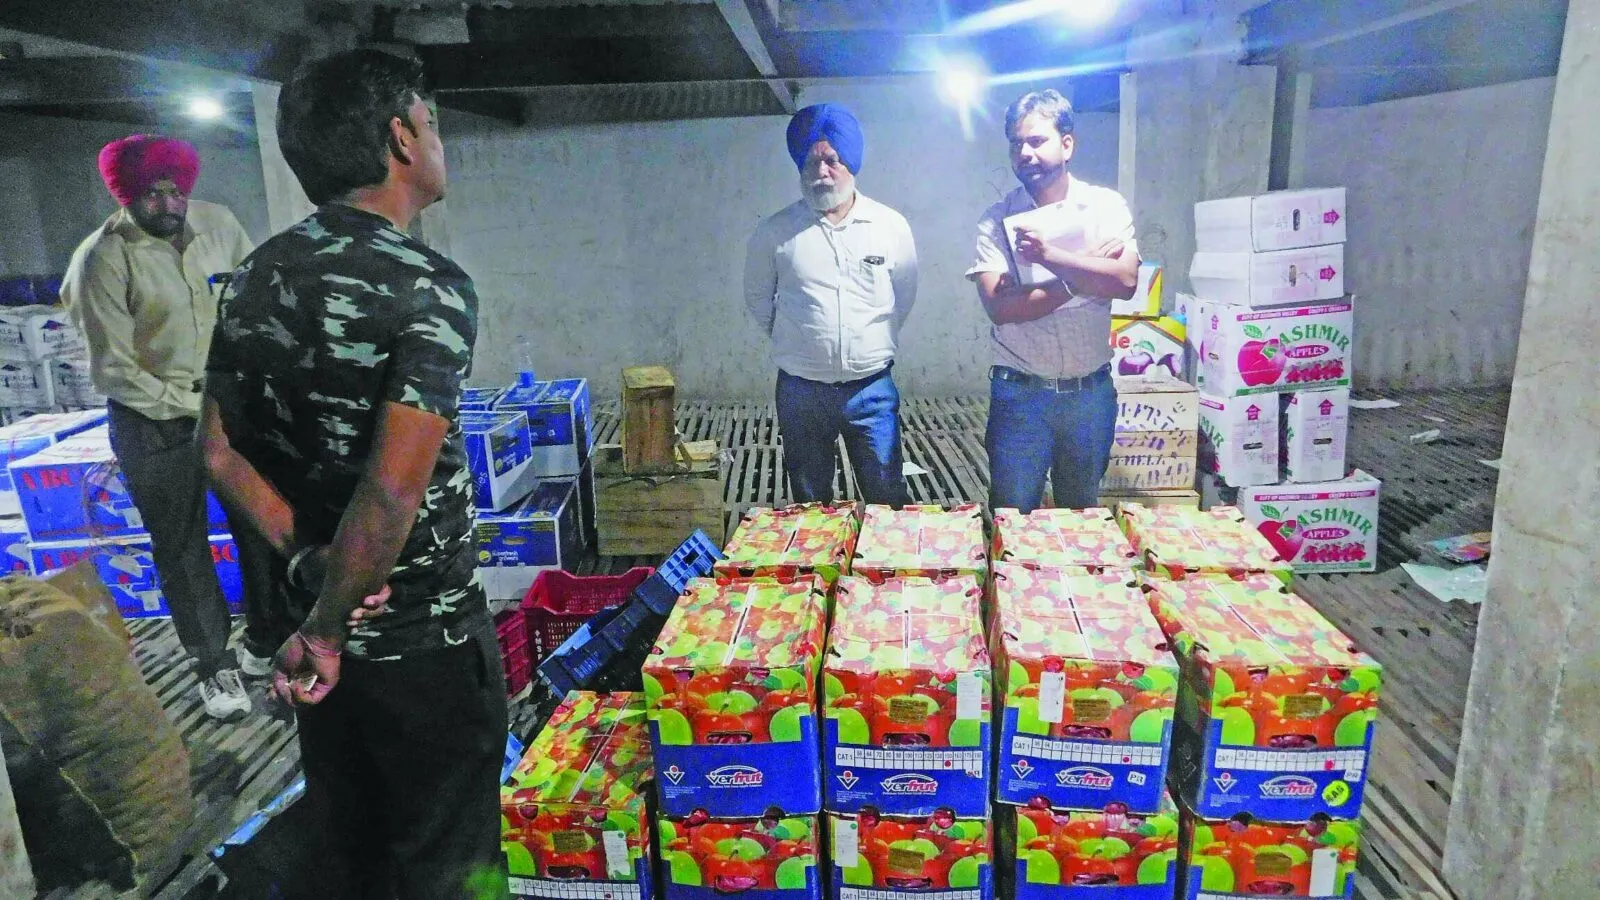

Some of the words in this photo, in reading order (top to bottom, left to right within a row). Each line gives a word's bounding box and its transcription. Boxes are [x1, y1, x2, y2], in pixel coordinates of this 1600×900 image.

[1109, 331, 1131, 349] le
[1290, 347, 1326, 357] APPLES
[1307, 530, 1345, 539] APPLES
